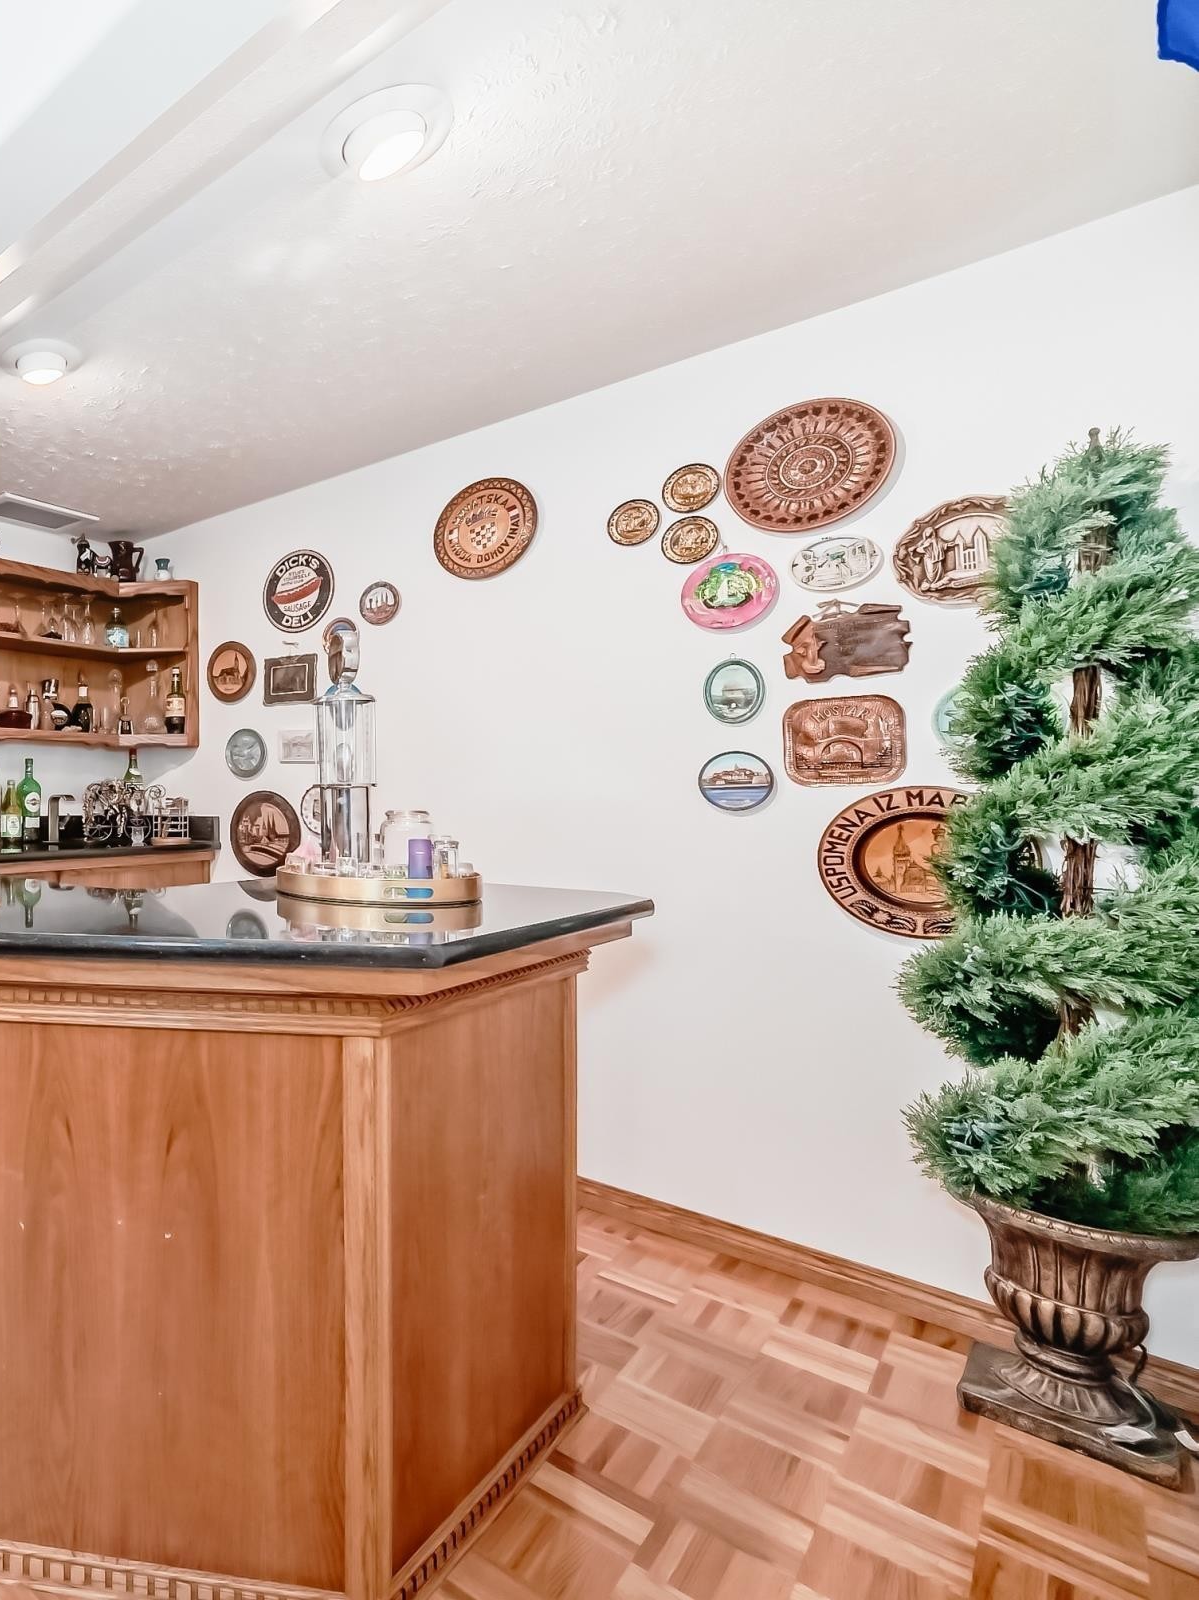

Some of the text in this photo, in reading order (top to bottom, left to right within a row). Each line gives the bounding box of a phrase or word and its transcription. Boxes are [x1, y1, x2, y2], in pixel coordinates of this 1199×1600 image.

[276, 555, 320, 577] DICK'S
[284, 602, 311, 612] SAUSAGE
[282, 612, 313, 627] DELI
[812, 705, 870, 723] MOSTAR
[823, 789, 969, 900] USPOMENA IZ MAR
